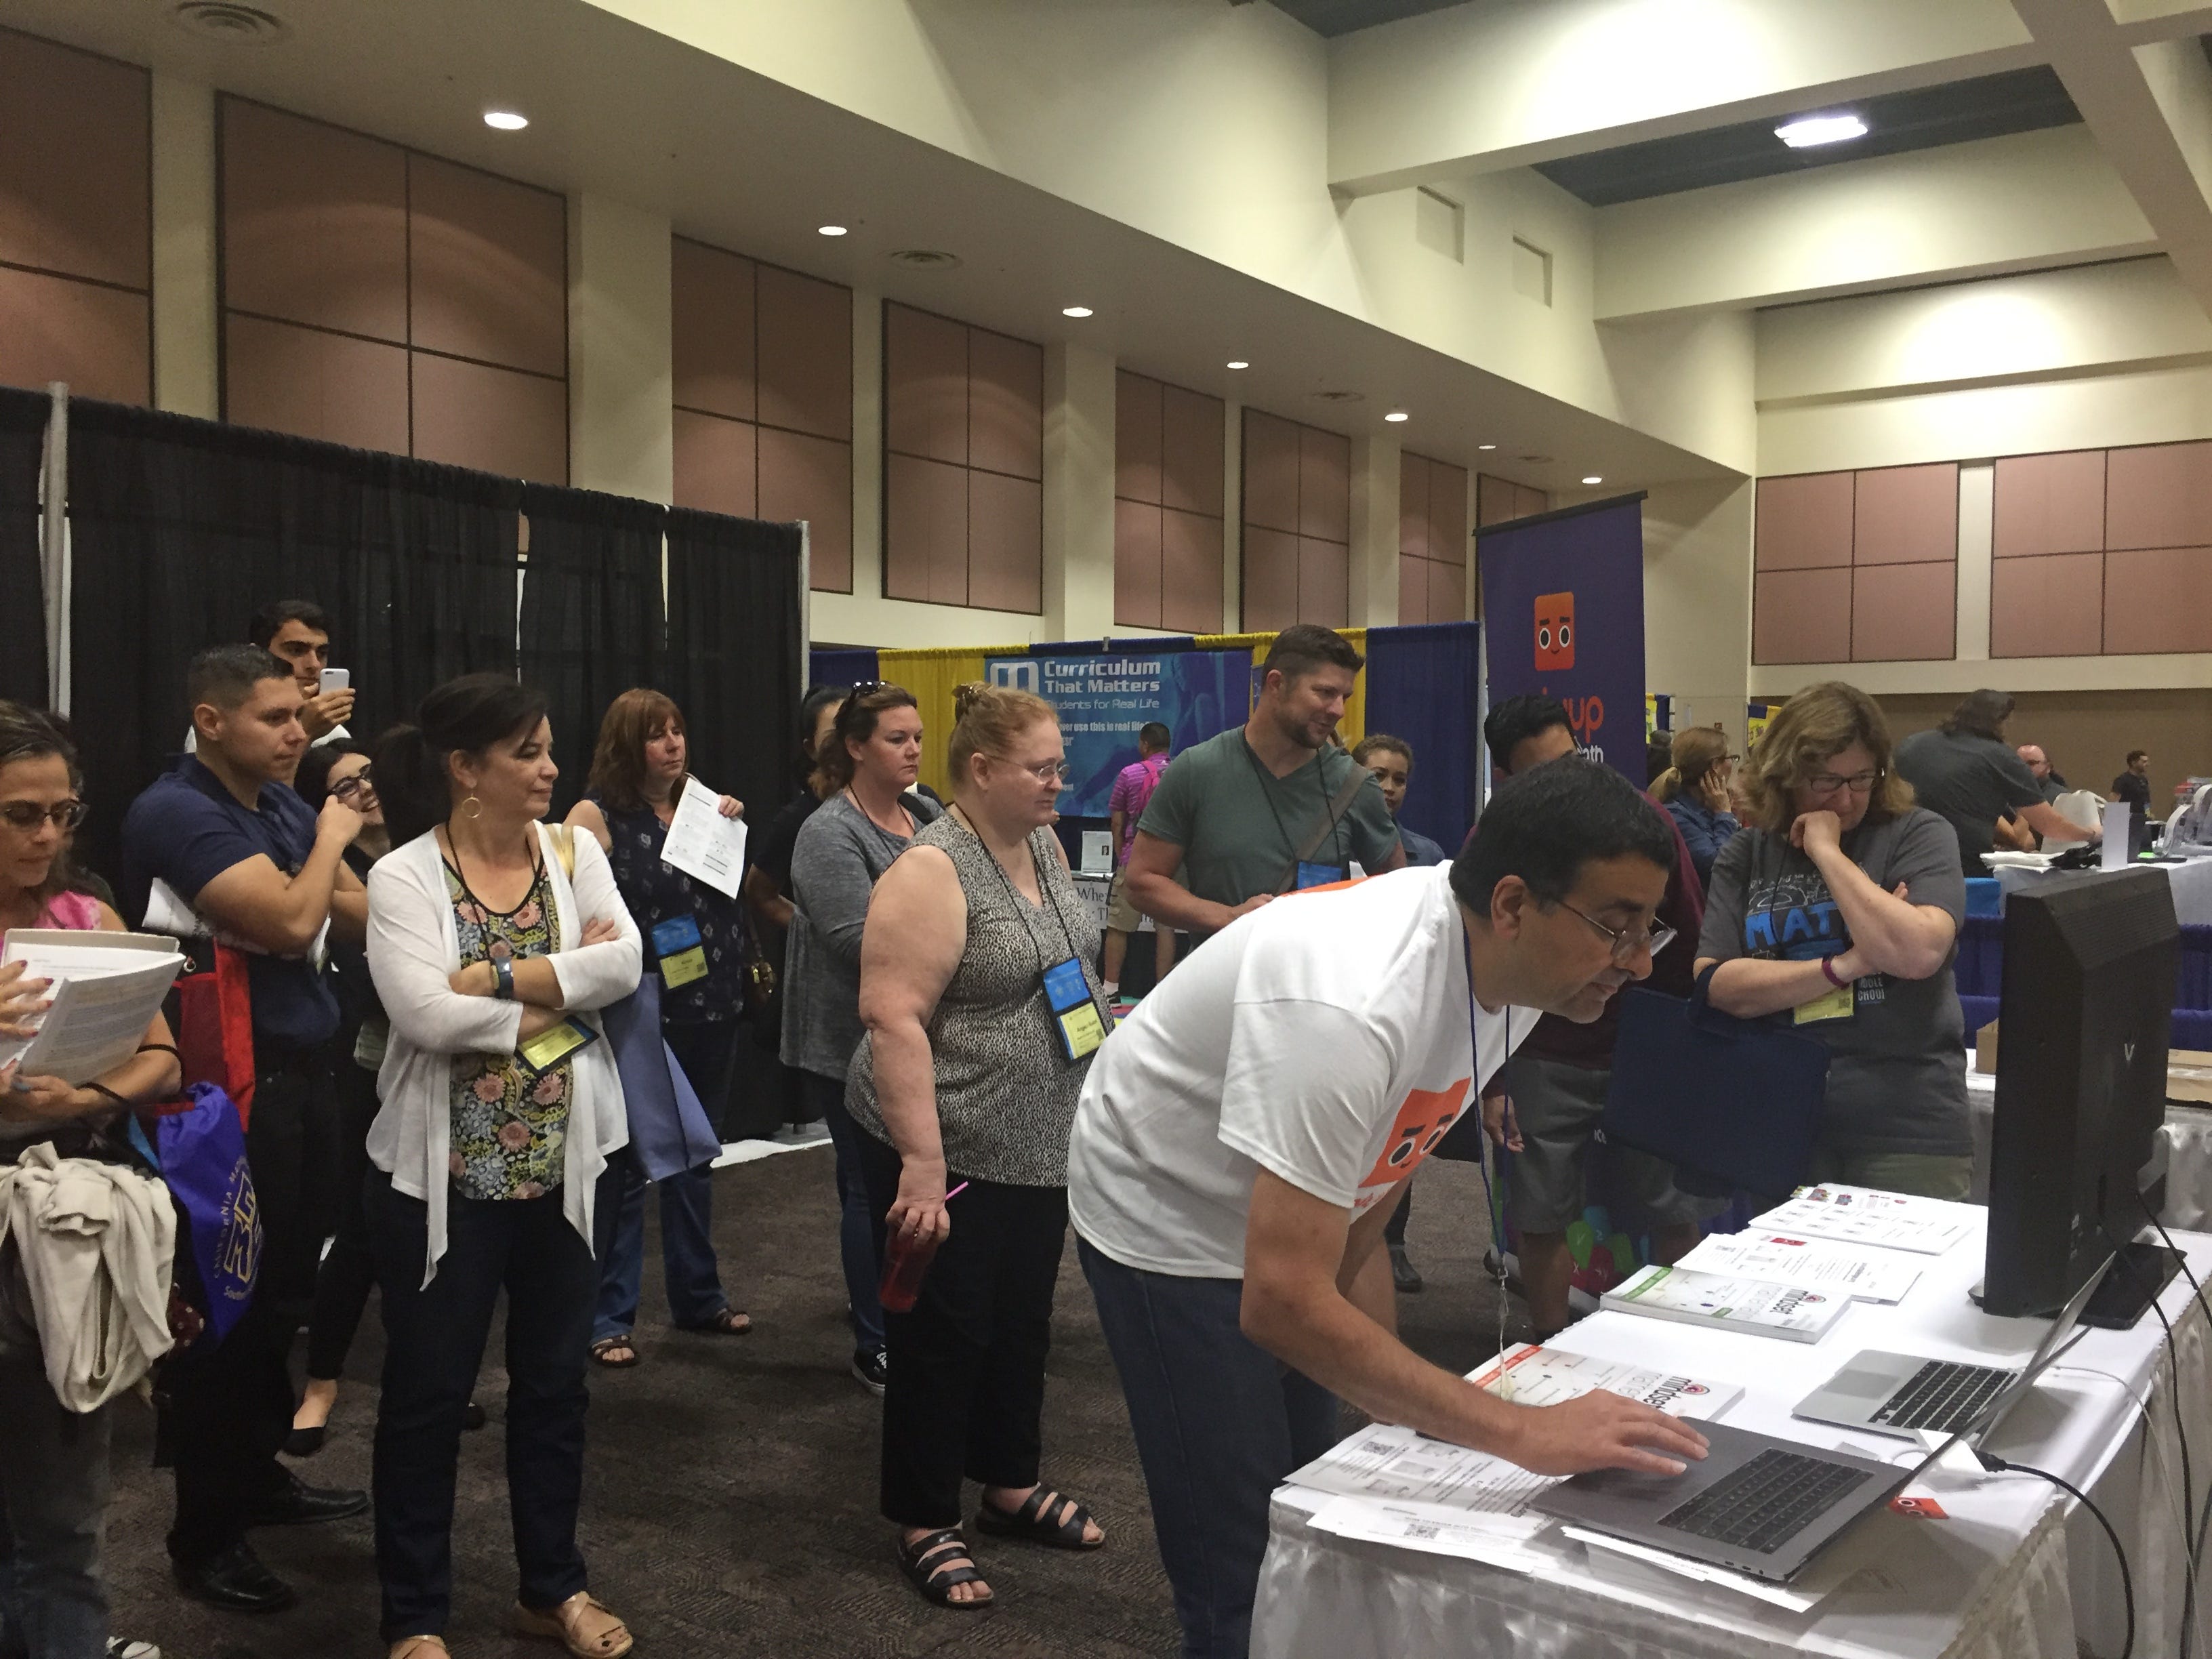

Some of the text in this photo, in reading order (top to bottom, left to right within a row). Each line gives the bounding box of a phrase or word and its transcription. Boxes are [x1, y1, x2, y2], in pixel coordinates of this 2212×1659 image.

[1044, 659, 1161, 677] Curriculum
[1044, 679, 1160, 693] That Matters
[1094, 698, 1109, 709] for
[1112, 699, 1136, 708] Real
[1139, 699, 1160, 708] Life
[1090, 721, 1106, 732] this
